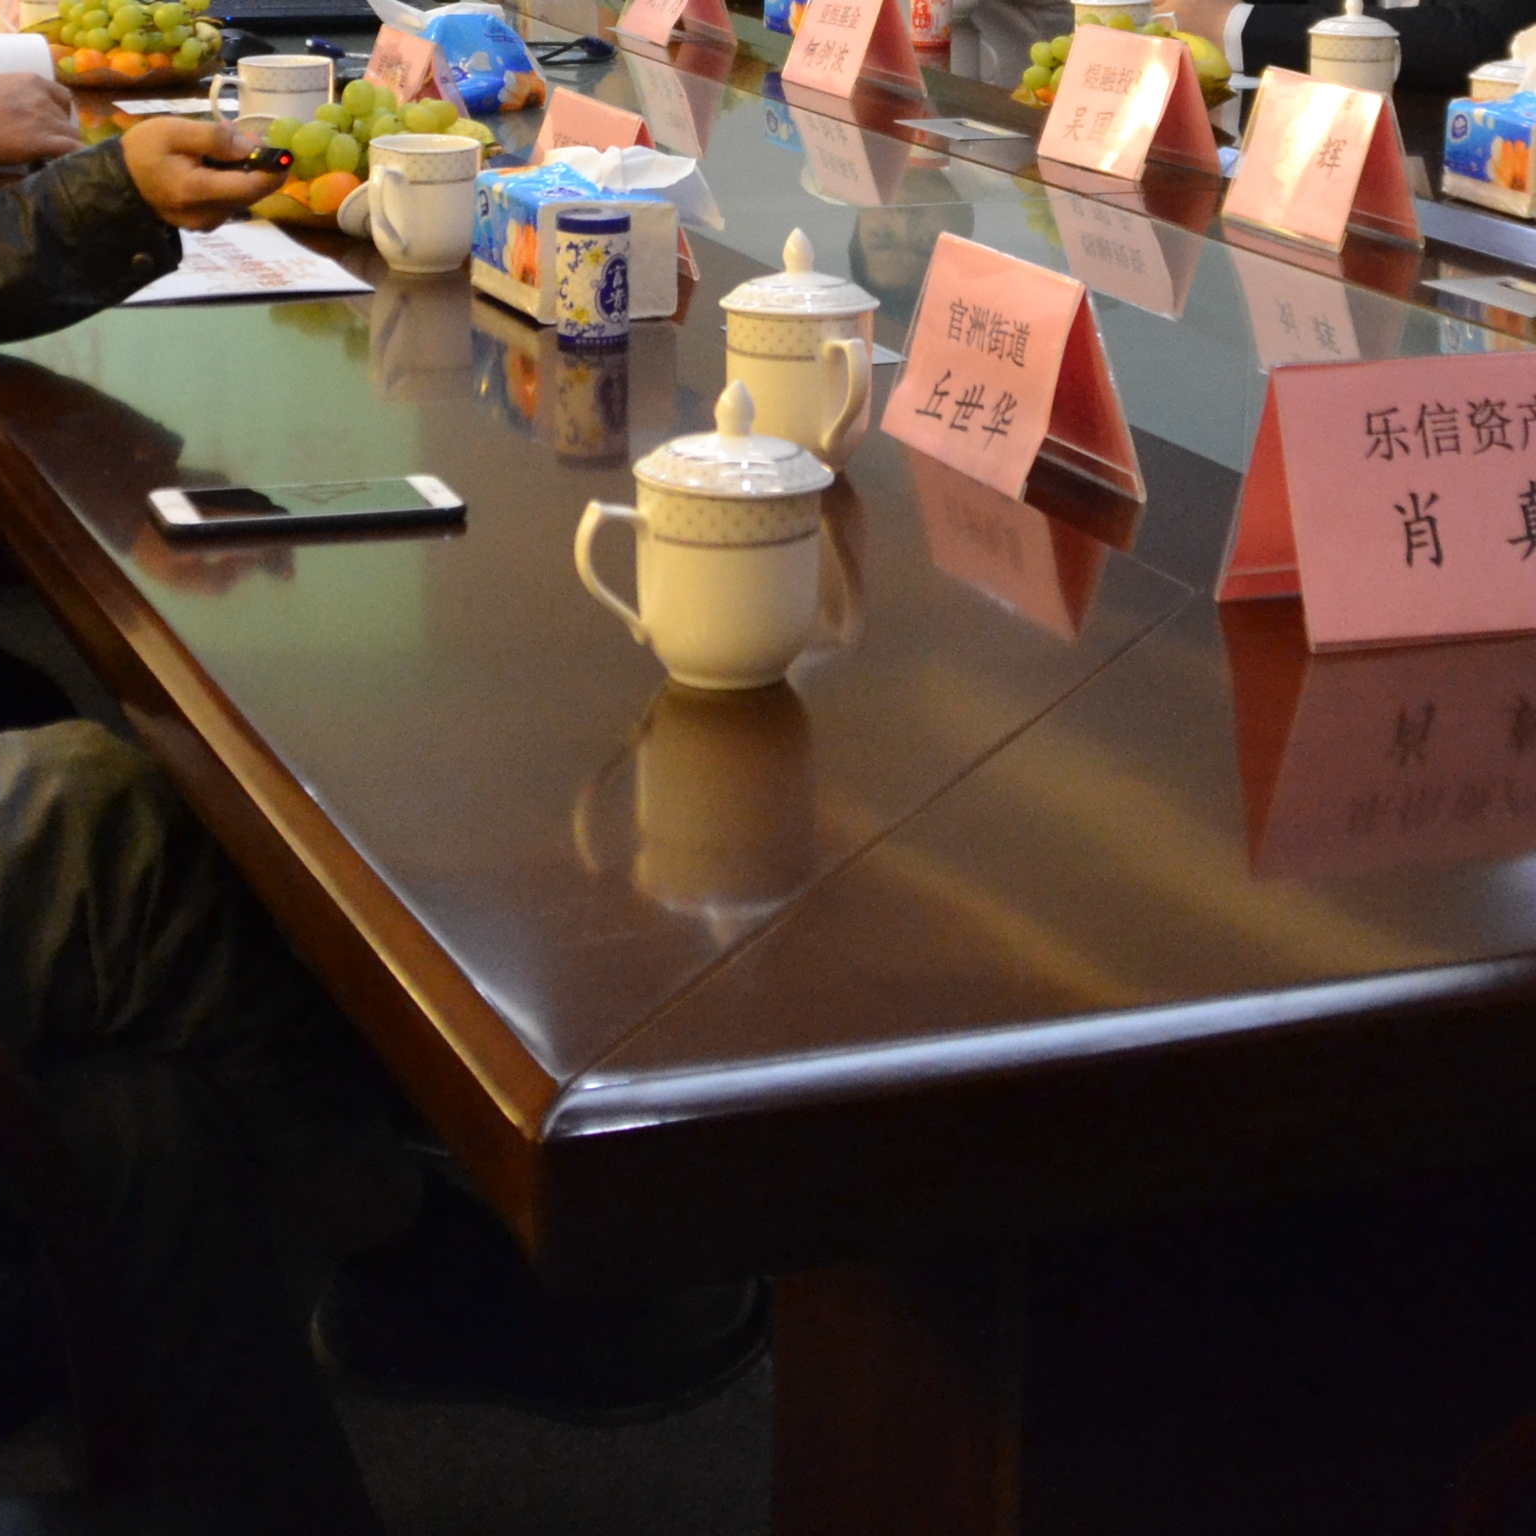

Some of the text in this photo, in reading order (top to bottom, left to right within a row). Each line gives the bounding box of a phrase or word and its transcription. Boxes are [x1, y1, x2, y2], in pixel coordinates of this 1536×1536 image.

[947, 296, 1031, 370] 官洲街道
[915, 368, 1020, 442] 丘世华
